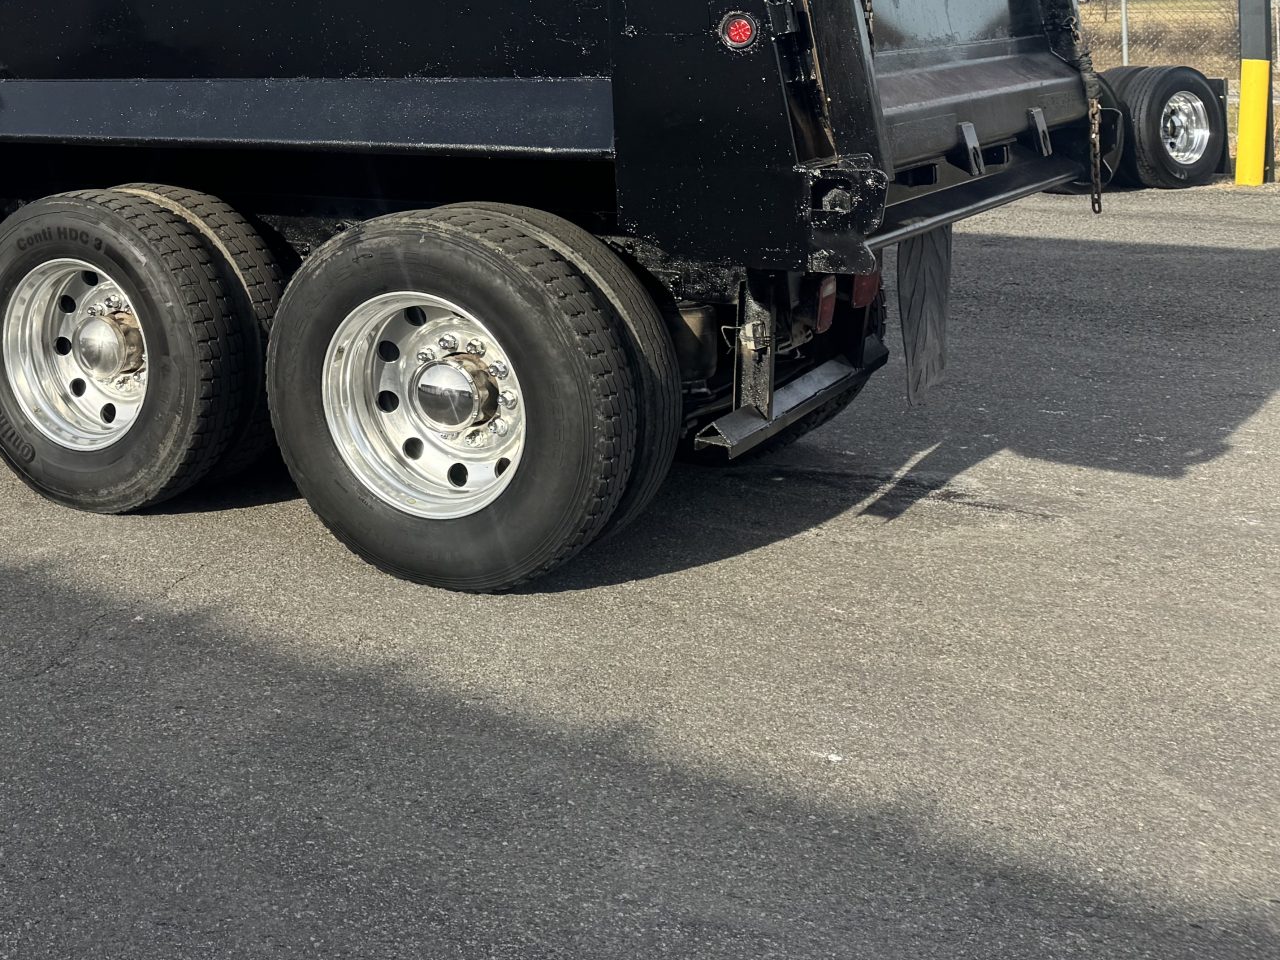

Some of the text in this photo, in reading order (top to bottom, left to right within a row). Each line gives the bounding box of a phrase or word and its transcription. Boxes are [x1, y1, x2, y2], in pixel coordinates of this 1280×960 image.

[17, 226, 103, 251] Conti HDC 3
